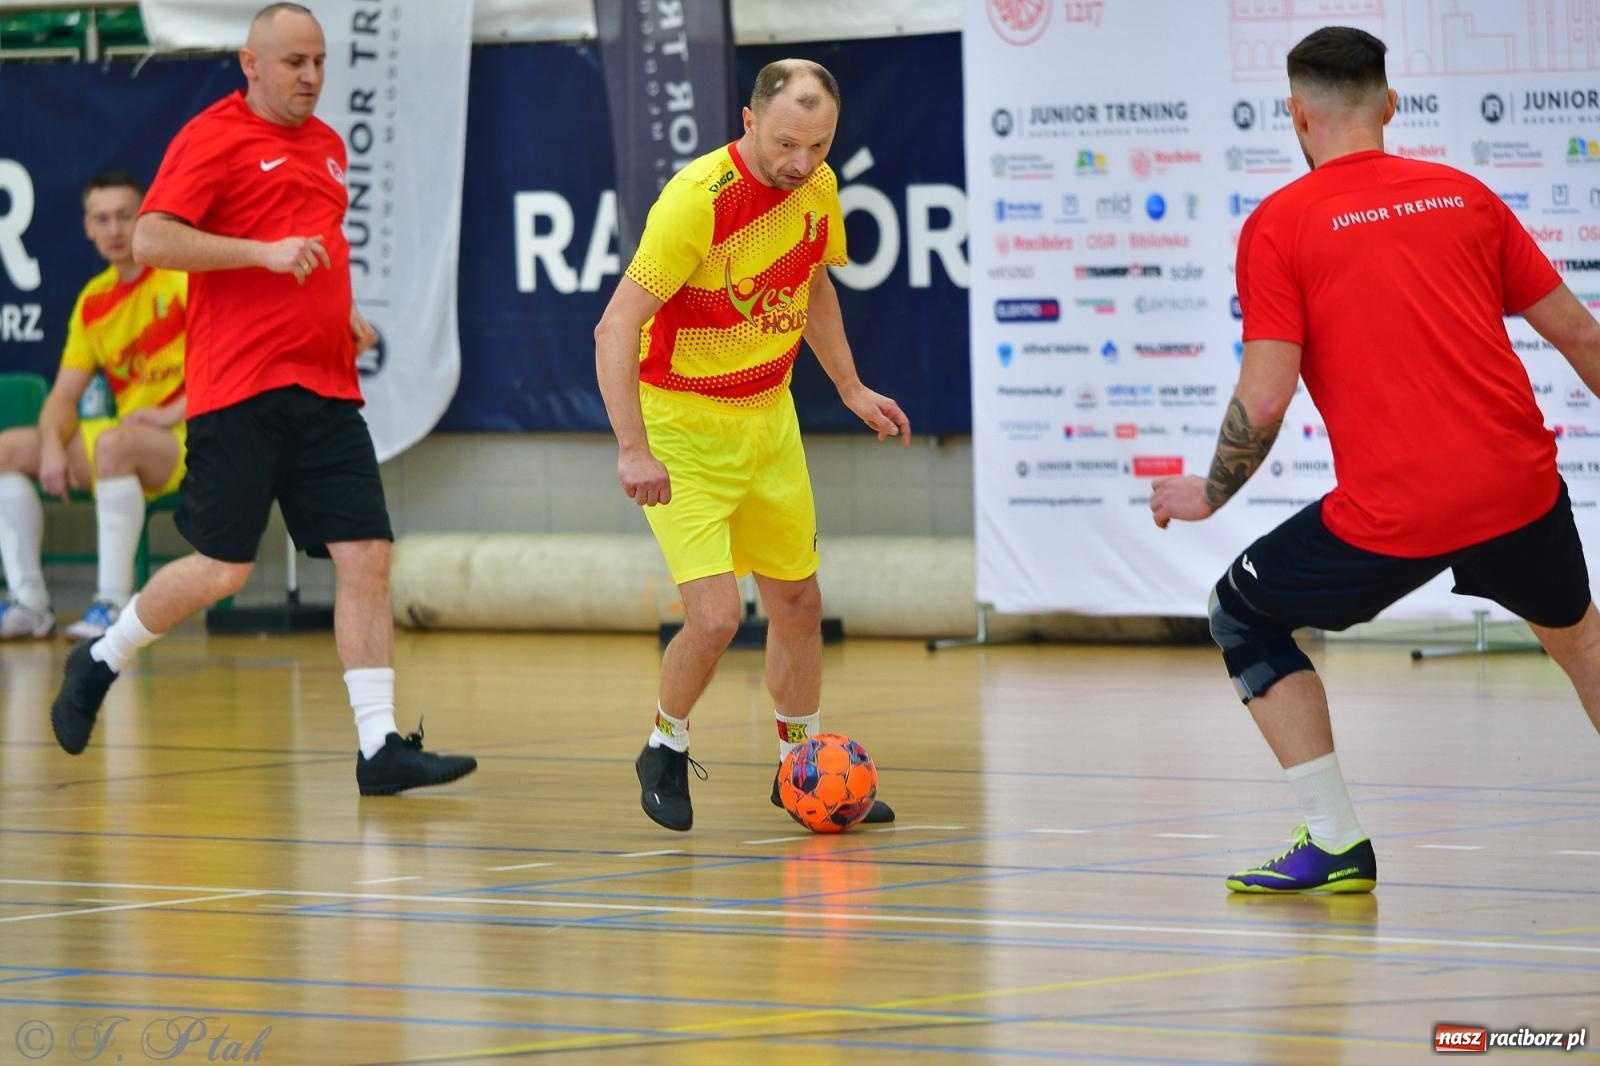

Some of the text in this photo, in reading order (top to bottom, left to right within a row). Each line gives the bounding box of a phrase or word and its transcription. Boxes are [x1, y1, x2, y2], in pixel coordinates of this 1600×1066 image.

[1028, 101, 1189, 126] JUNIOR TRENING
[1525, 90, 1600, 110] JUNIOR
[349, 0, 381, 276] JUNIOR TR
[1331, 195, 1466, 232] JUNIOR TRENING
[0, 304, 44, 342] RZ
